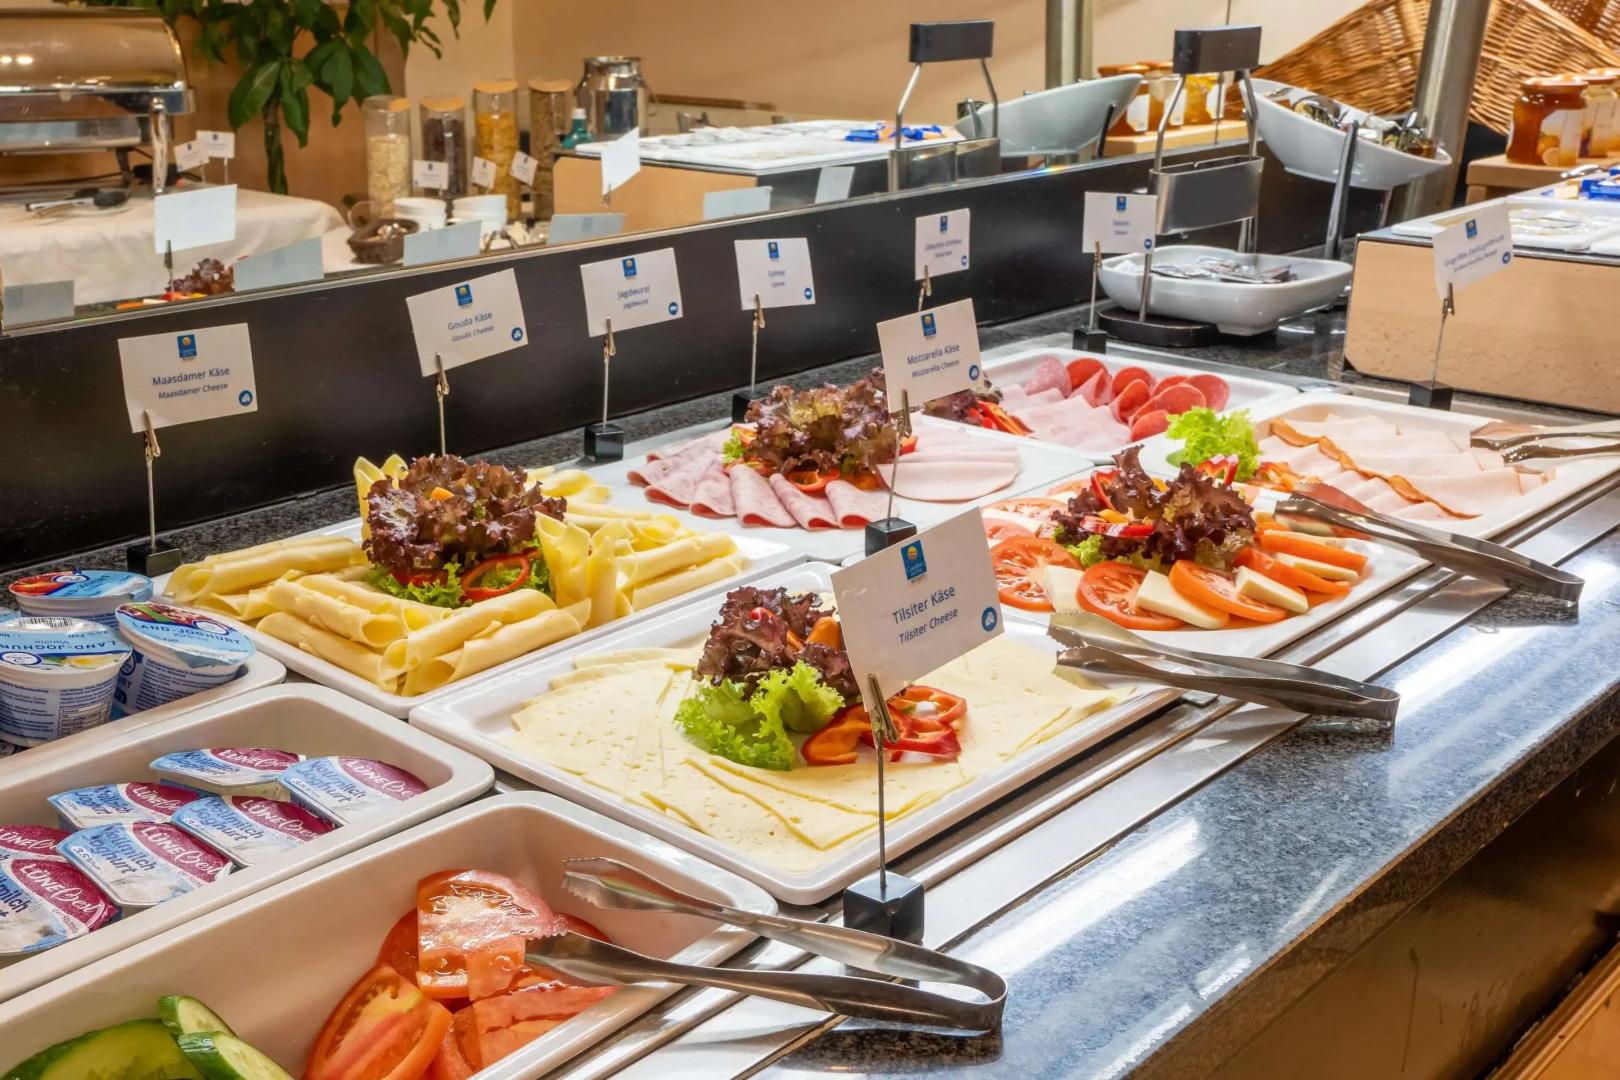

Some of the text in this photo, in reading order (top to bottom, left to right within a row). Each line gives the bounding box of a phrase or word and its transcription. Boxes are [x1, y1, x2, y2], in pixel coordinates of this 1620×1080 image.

[617, 286, 650, 300] Jagdwurst
[447, 312, 493, 331] Gouda Käse
[451, 325, 495, 343] Gouda Cheese
[906, 343, 960, 365] Mozzarella Käse
[152, 367, 230, 387] Maasdamer Käse
[911, 359, 960, 378] Mozzarella Cheese
[158, 382, 229, 400] Maasdamer Cheese
[892, 586, 956, 625] Tilsiter Käse
[132, 621, 241, 645] LAND-JOGHURT
[899, 608, 958, 645] Tilsiter Cheese
[0, 640, 116, 650] LAND-JOGHUR
[296, 769, 352, 803] Joghurt
[310, 760, 367, 799] Vollmilch
[189, 806, 249, 841] Joghurt
[203, 799, 264, 839] Vollmilch
[102, 824, 158, 872] Vollmilch
